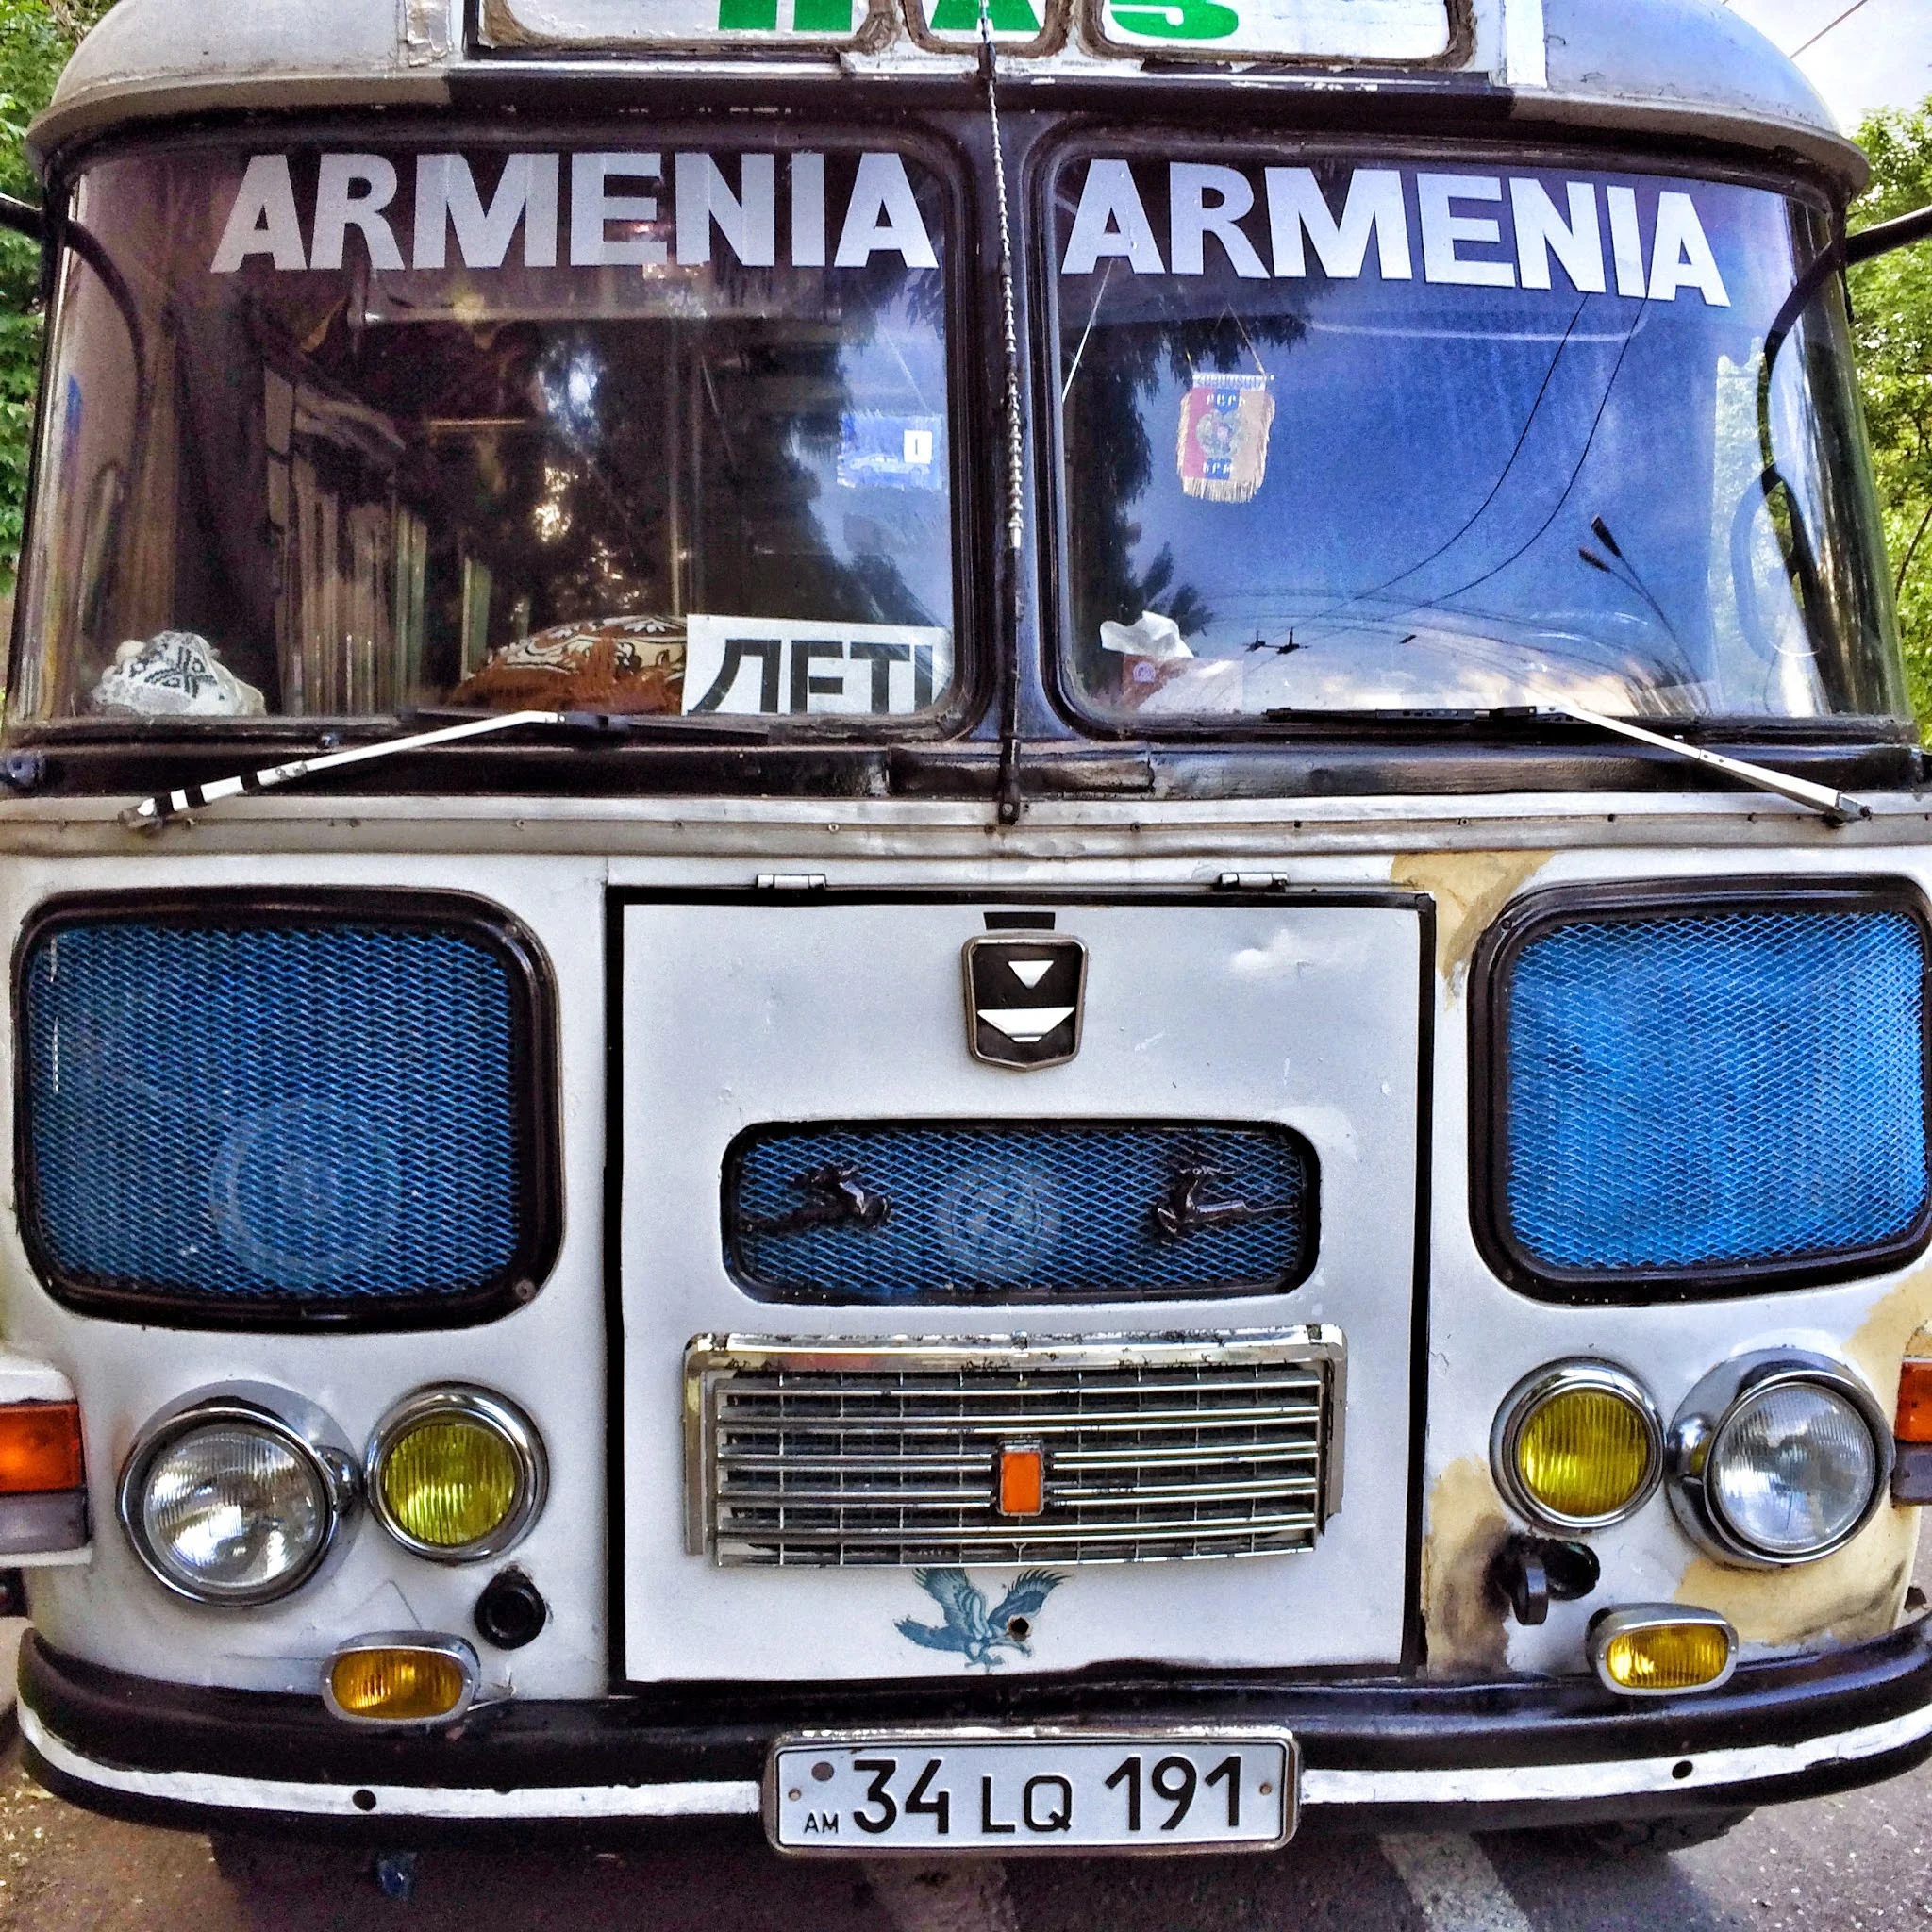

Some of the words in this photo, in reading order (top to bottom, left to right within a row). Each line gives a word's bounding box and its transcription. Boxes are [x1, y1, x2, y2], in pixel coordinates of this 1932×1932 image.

[209, 152, 939, 271] ARMENIA
[1061, 158, 1730, 307] ARMENIA
[804, 1812, 838, 1833] AM
[853, 1759, 949, 1834] 34
[982, 1775, 1073, 1834] LQ
[1104, 1755, 1241, 1831] 191
